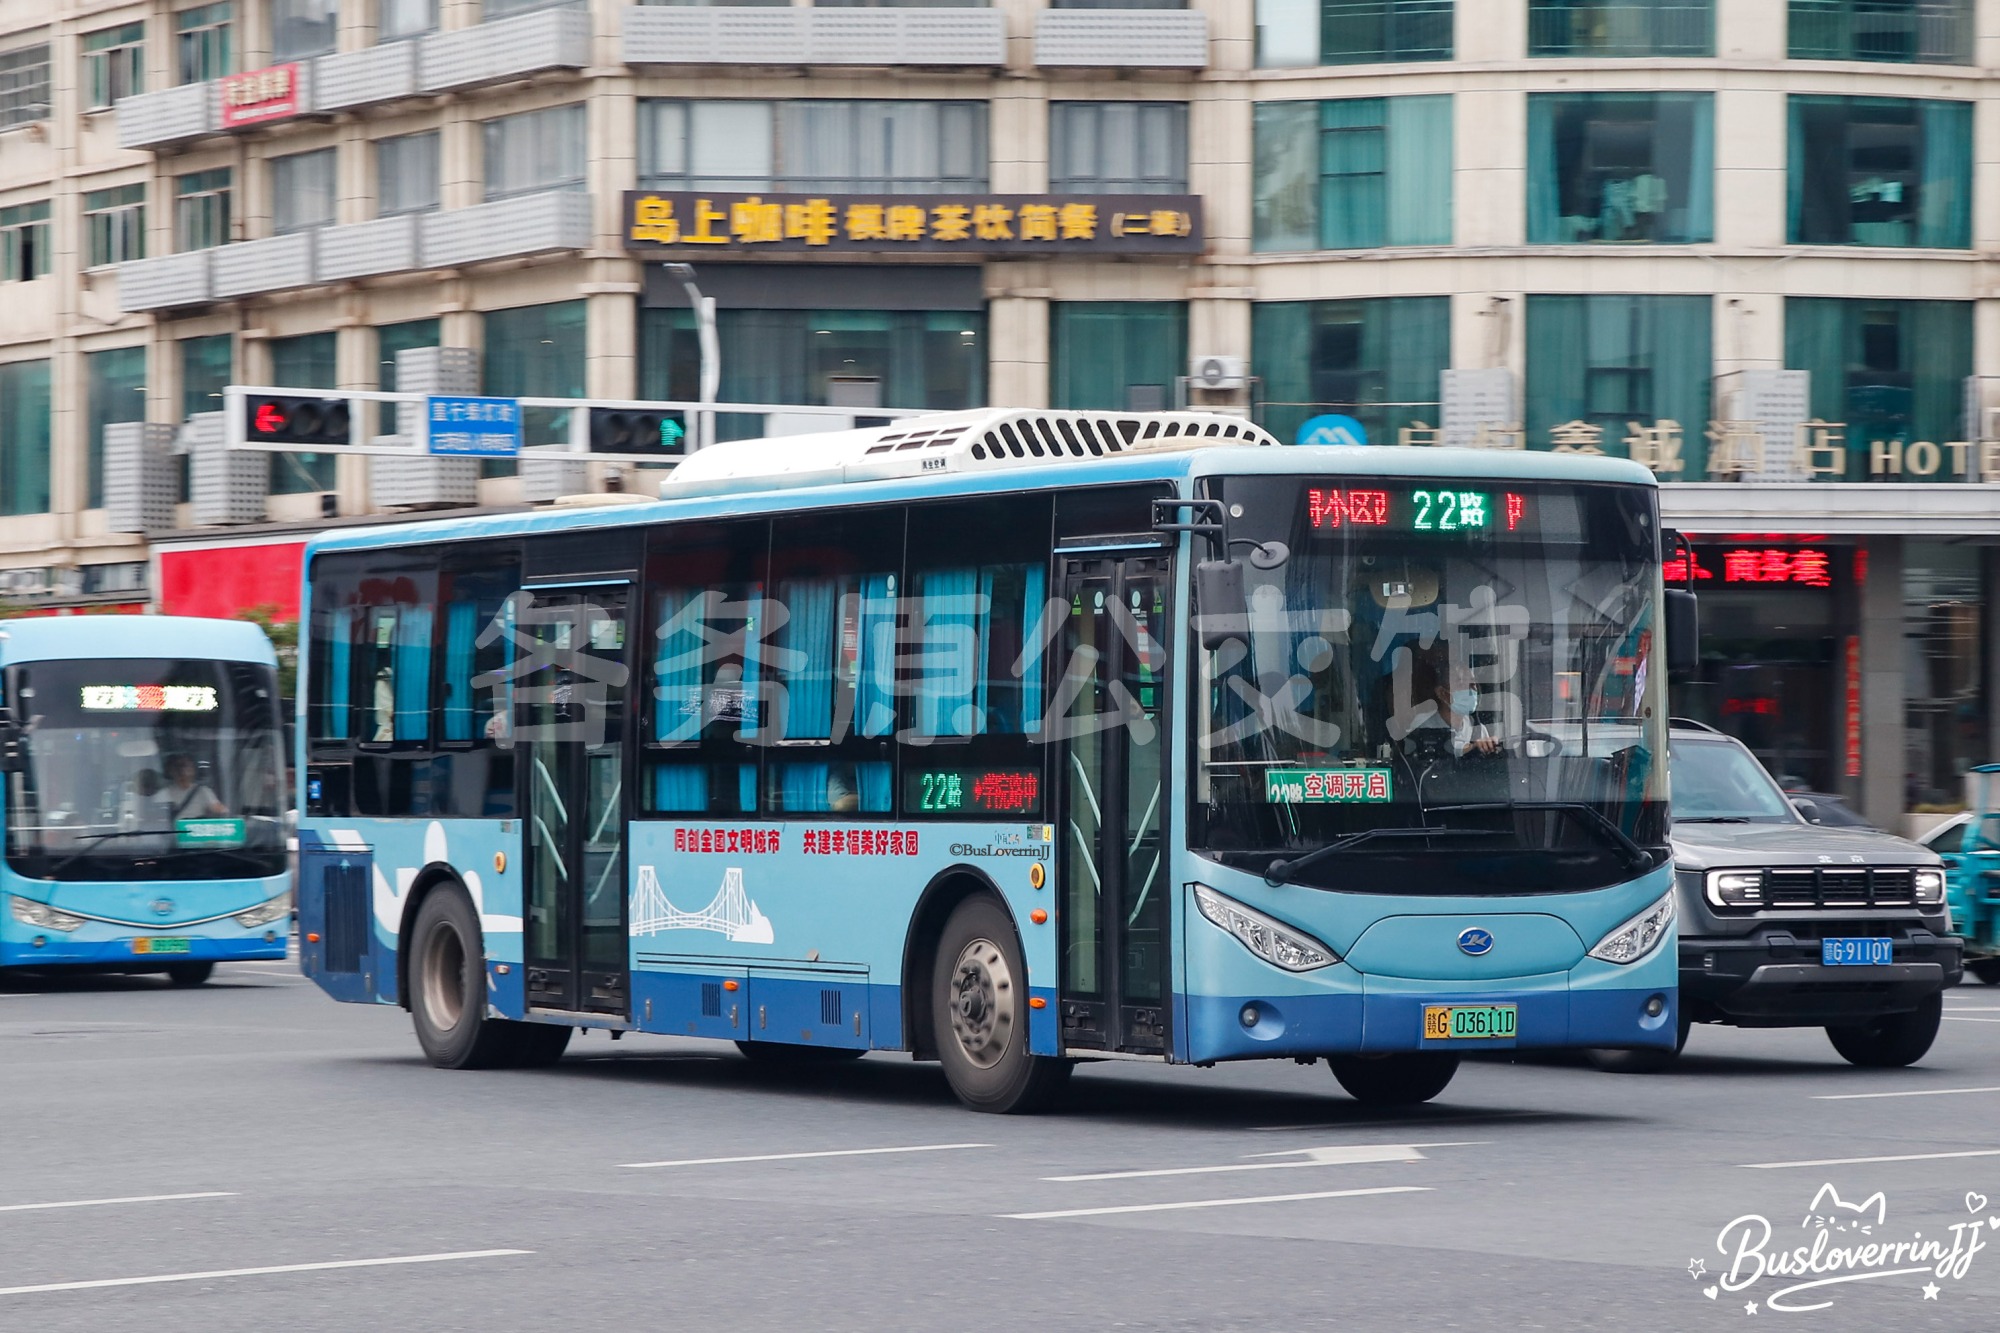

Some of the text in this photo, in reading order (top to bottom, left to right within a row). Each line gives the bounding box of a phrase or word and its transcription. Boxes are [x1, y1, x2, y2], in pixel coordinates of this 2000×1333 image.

[1413, 490, 1485, 529] 22路
[923, 773, 962, 809] 22路
[1304, 773, 1387, 798] 空调开启
[674, 828, 919, 856] 同创全国文明城市 共建幸福美好家园
